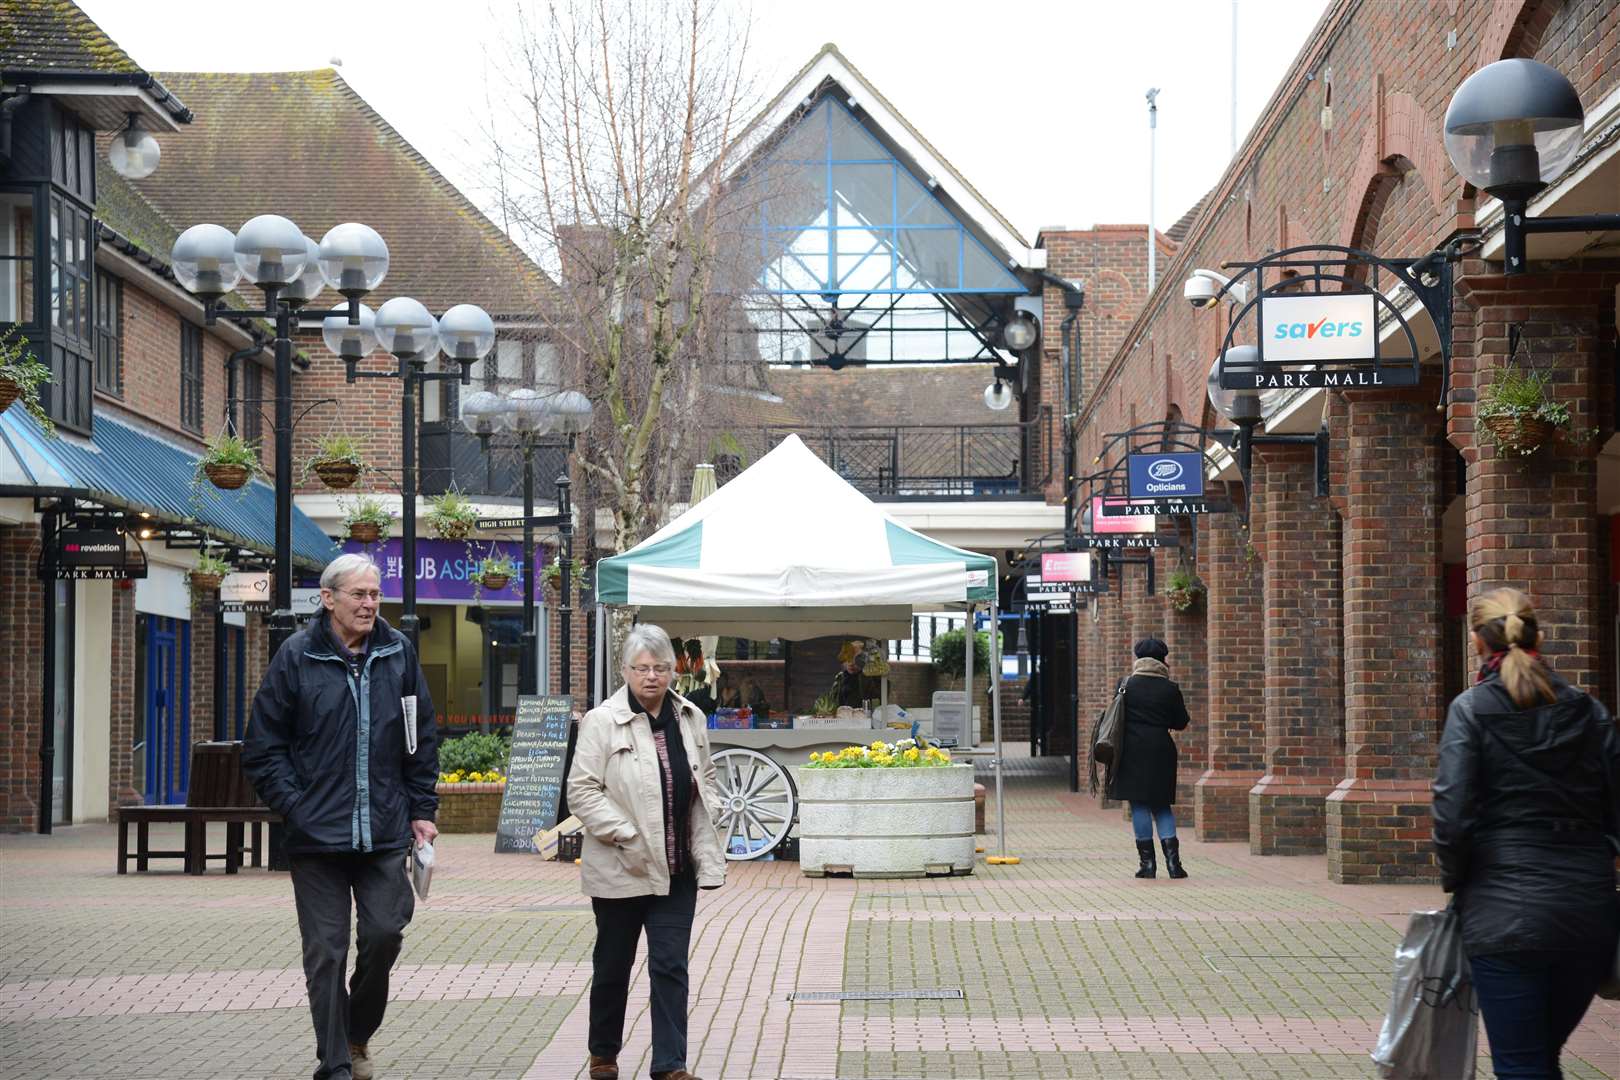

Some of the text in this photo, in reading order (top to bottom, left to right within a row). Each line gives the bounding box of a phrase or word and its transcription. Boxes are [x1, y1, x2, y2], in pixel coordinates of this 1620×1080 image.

[1274, 316, 1363, 340] savers
[1255, 372, 1383, 387] PARK MALL
[1146, 483, 1186, 492] Opticians
[1125, 504, 1209, 515] PARK MALL
[499, 519, 525, 528] STREET
[80, 543, 120, 552] revelation
[1088, 539, 1160, 548] PARK MALL
[386, 556, 397, 579] THE
[57, 570, 128, 579] PARK MALL
[1039, 585, 1064, 593] PARK
[1024, 603, 1047, 611] PARK
[502, 839, 538, 849] PRODUC
